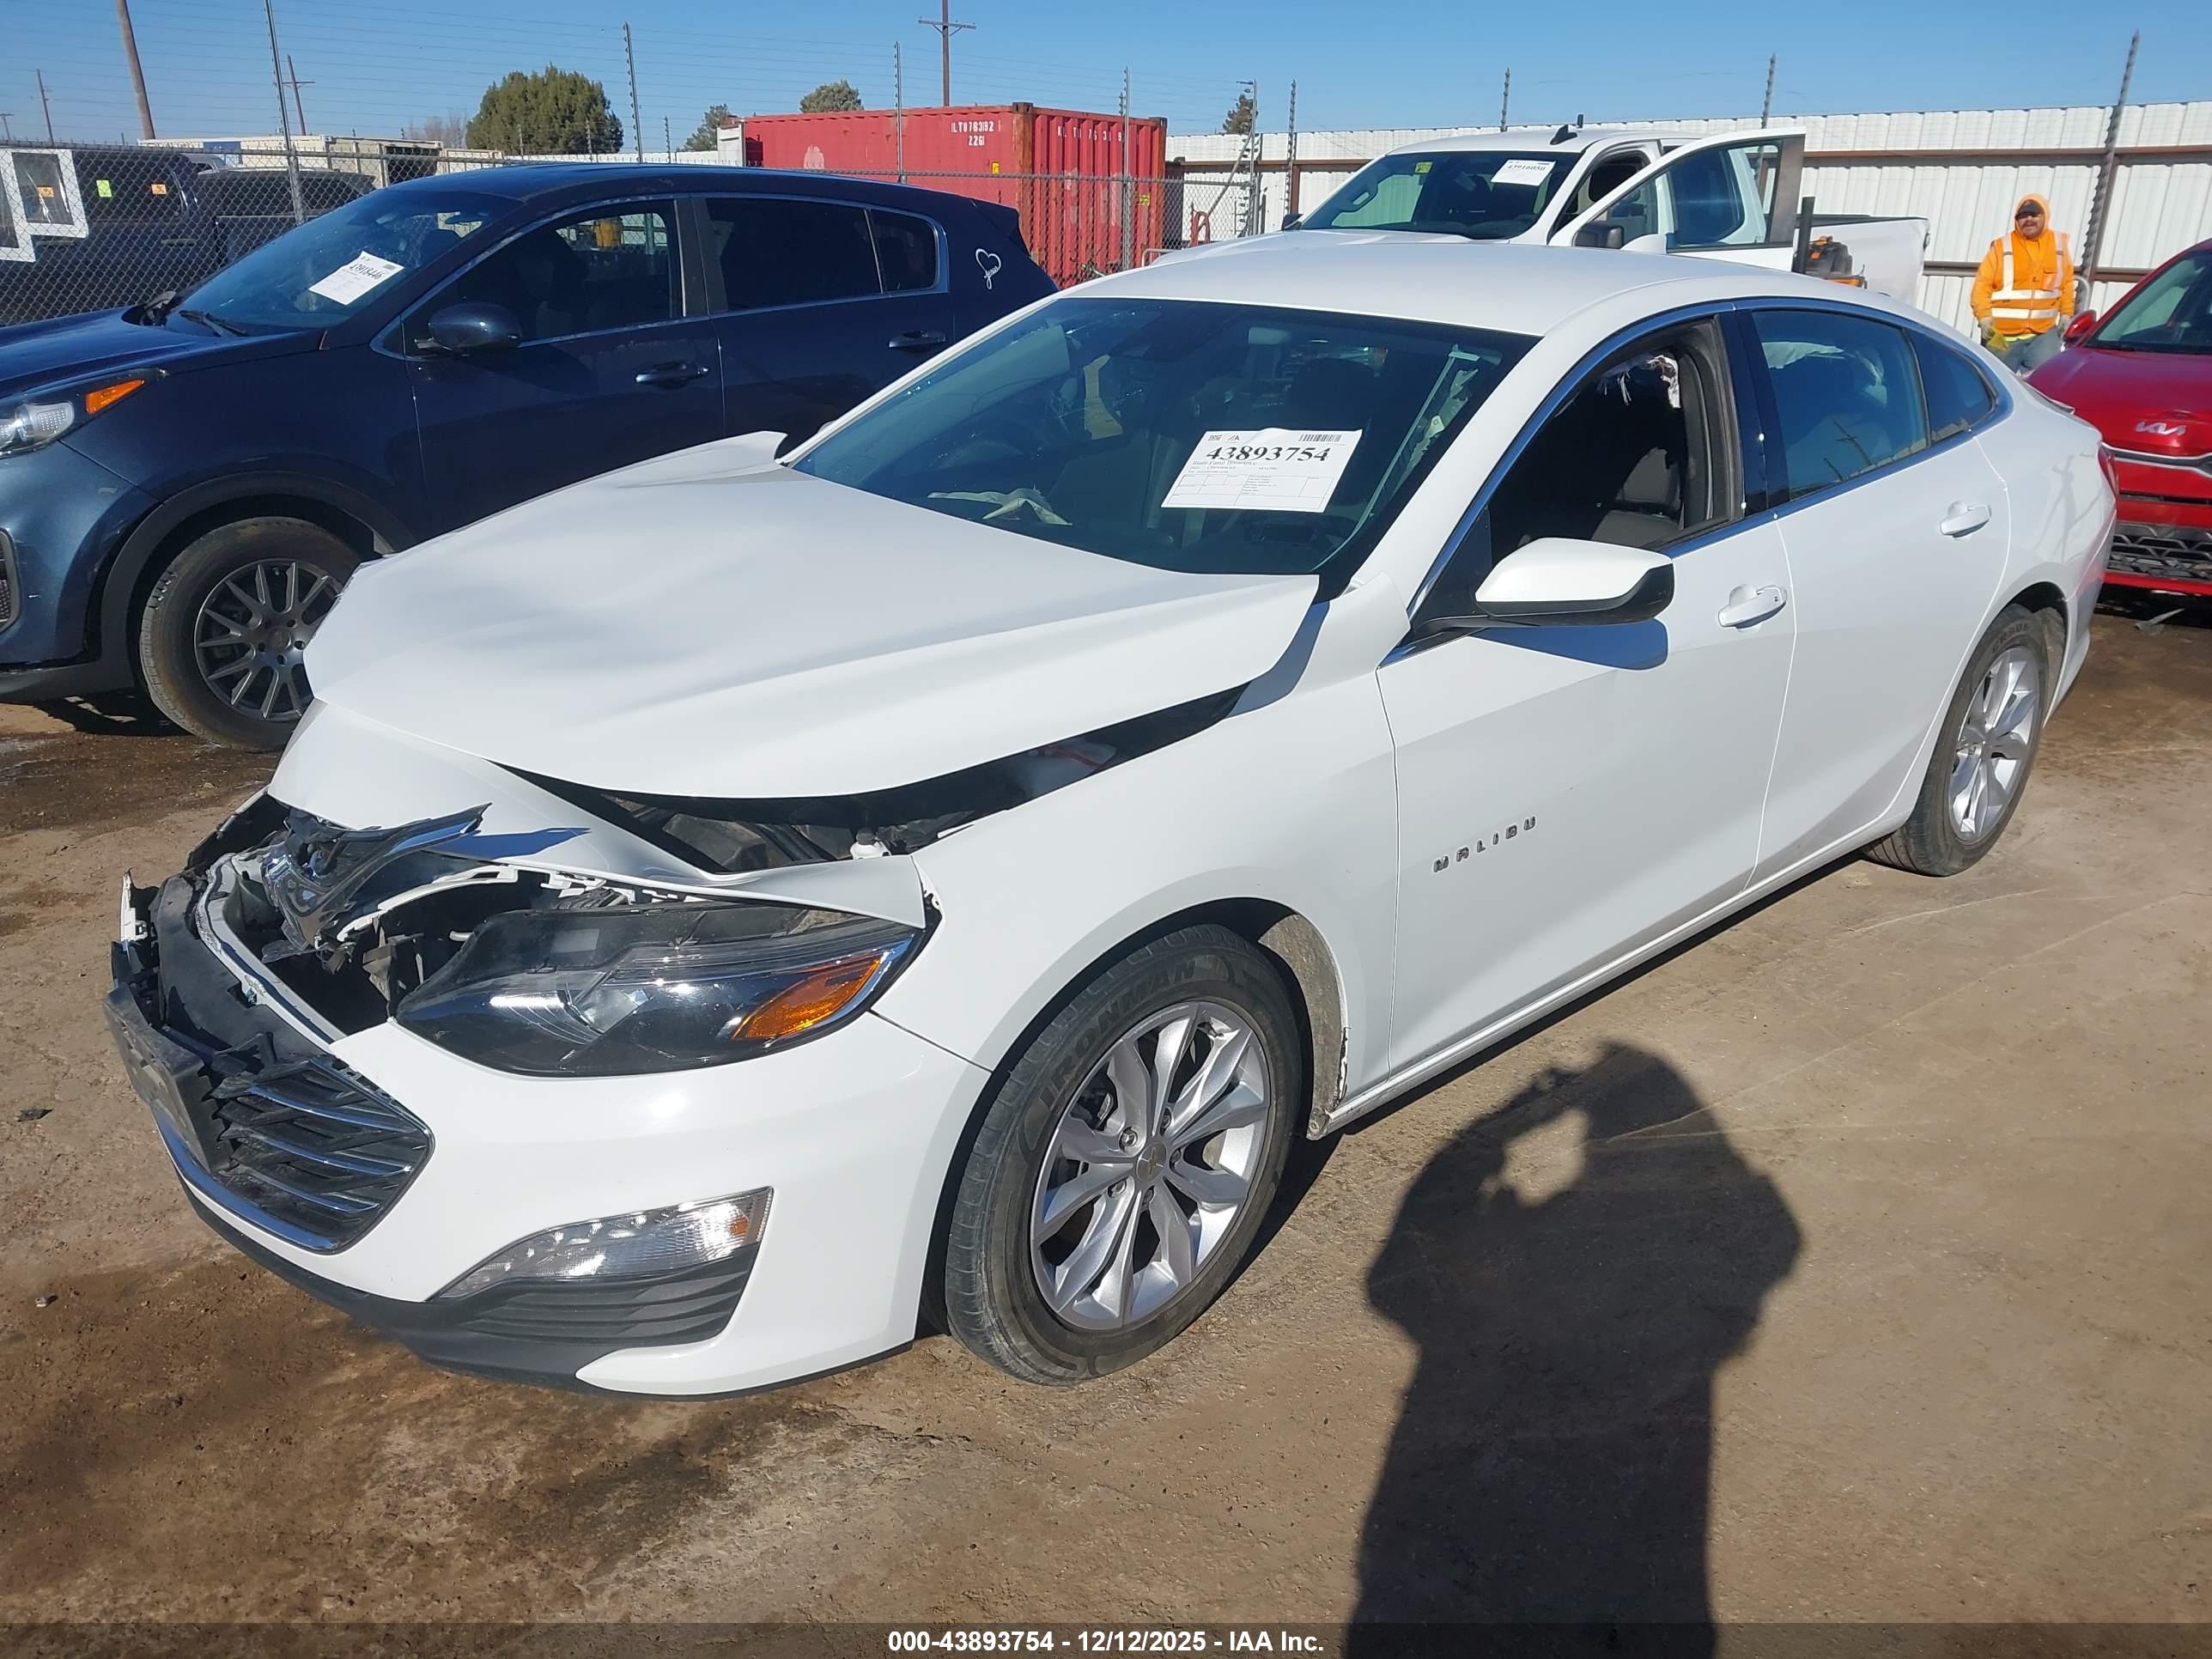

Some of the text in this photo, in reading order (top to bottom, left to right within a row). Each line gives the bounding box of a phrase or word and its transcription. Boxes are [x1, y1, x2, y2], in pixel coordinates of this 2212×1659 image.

[2136, 422, 2186, 435] KIA
[1206, 445, 1331, 461] 43893754
[1432, 815, 1536, 872] MALIBU
